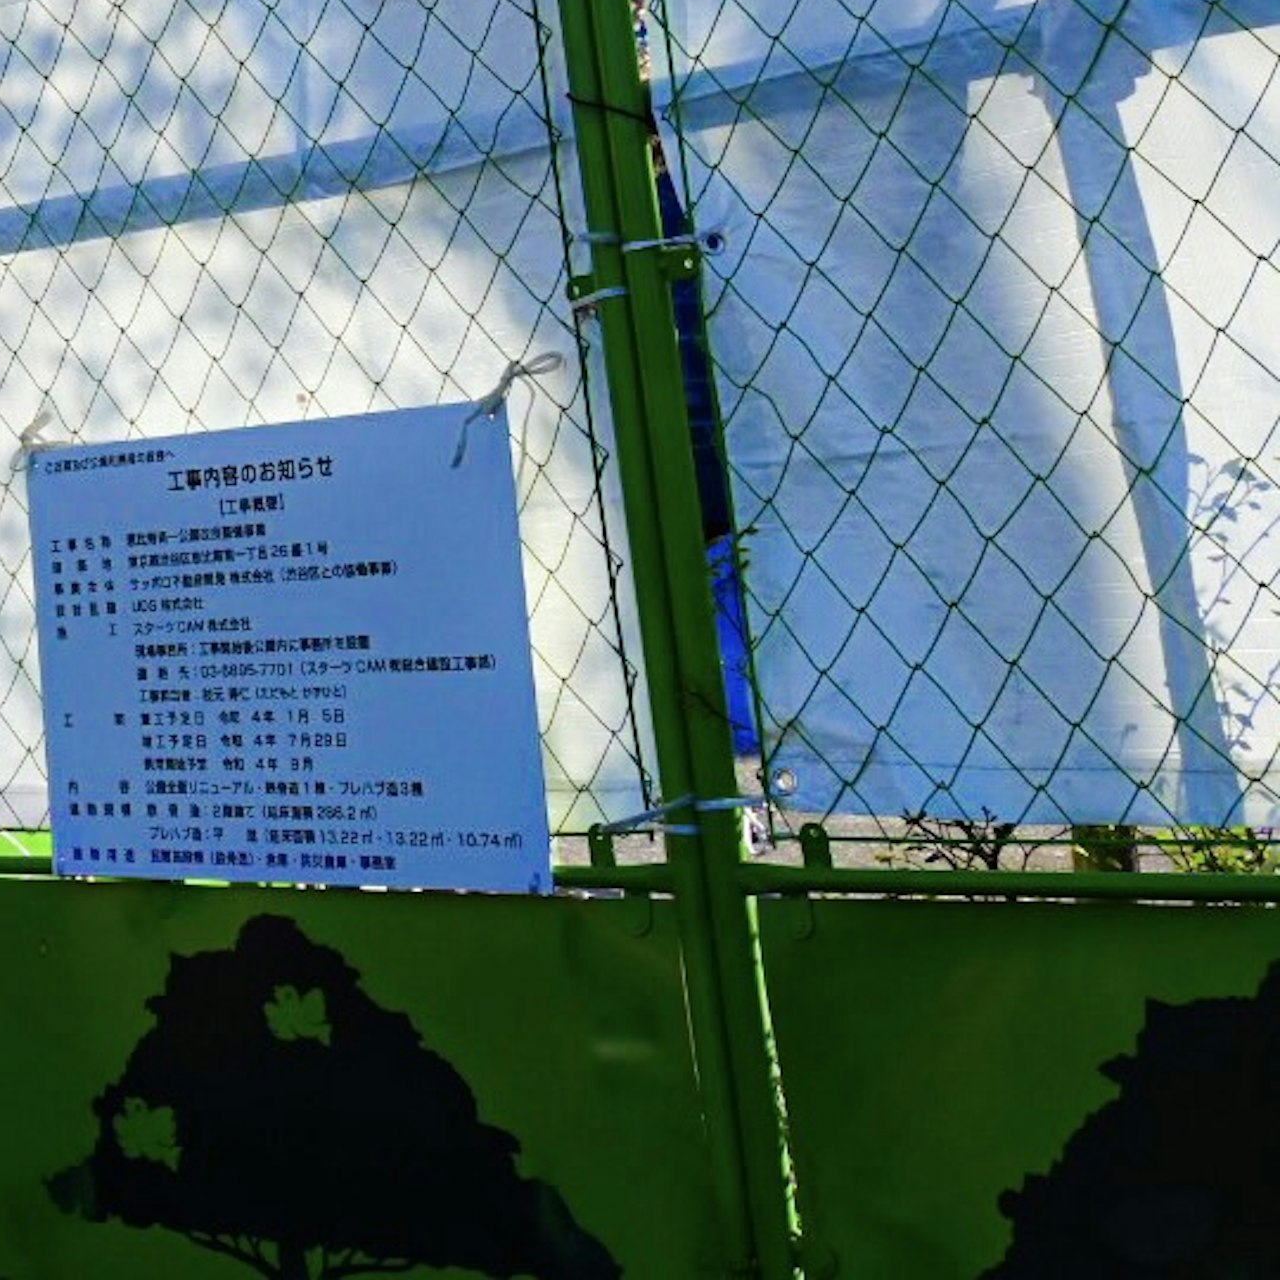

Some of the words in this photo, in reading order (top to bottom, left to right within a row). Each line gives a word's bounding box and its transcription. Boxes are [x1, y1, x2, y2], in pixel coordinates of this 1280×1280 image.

[166, 454, 334, 492] 工事内容のお知らせ
